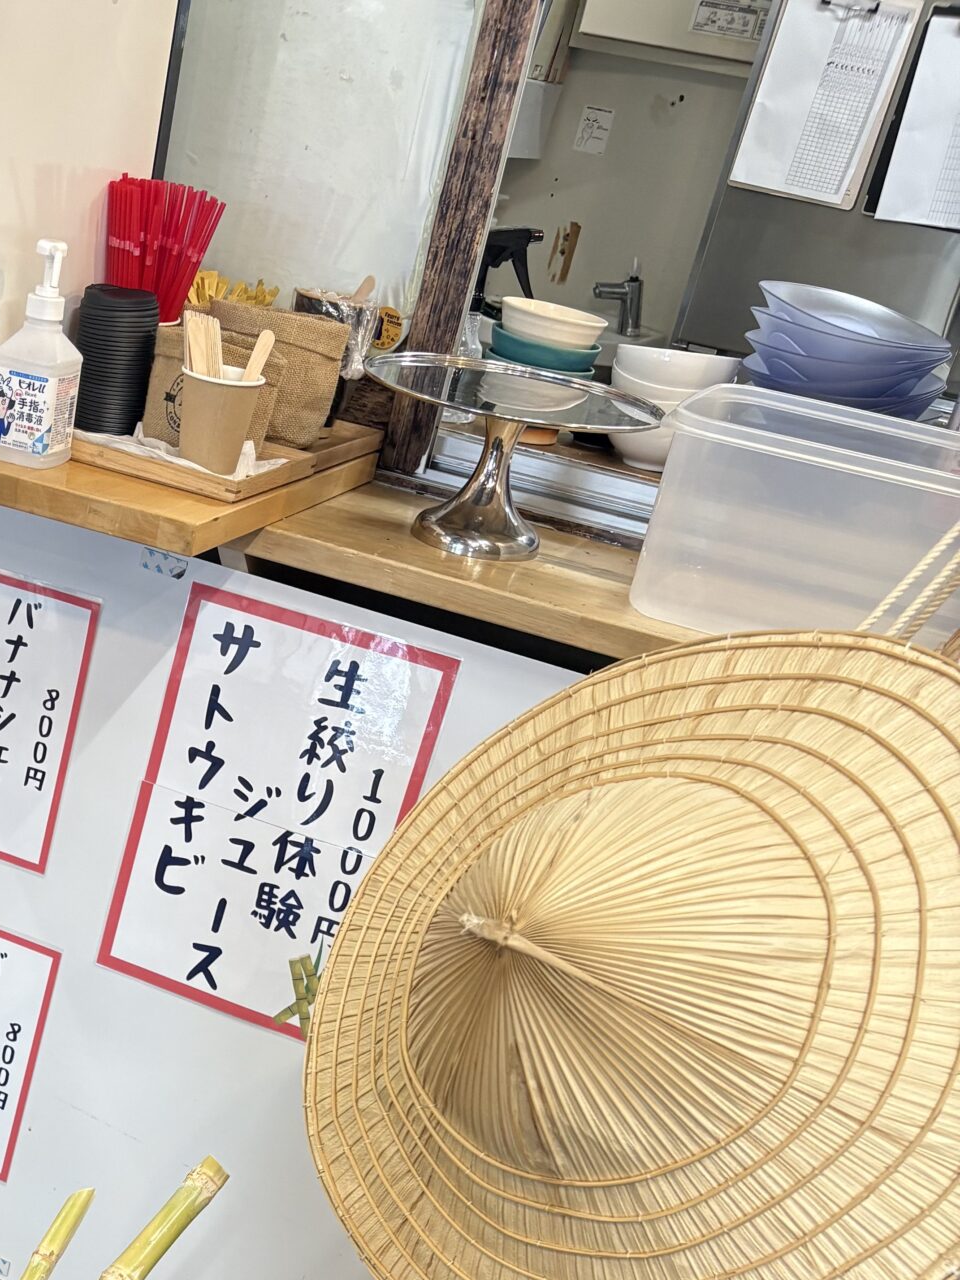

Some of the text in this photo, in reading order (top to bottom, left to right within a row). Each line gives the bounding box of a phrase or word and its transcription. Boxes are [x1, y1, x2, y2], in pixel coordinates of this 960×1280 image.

[23, 688, 61, 792] 800円
[153, 621, 262, 896] サトウキビ
[249, 658, 368, 940] 生絞り体験
[186, 775, 282, 991] ジュース
[310, 767, 385, 947] 1000円
